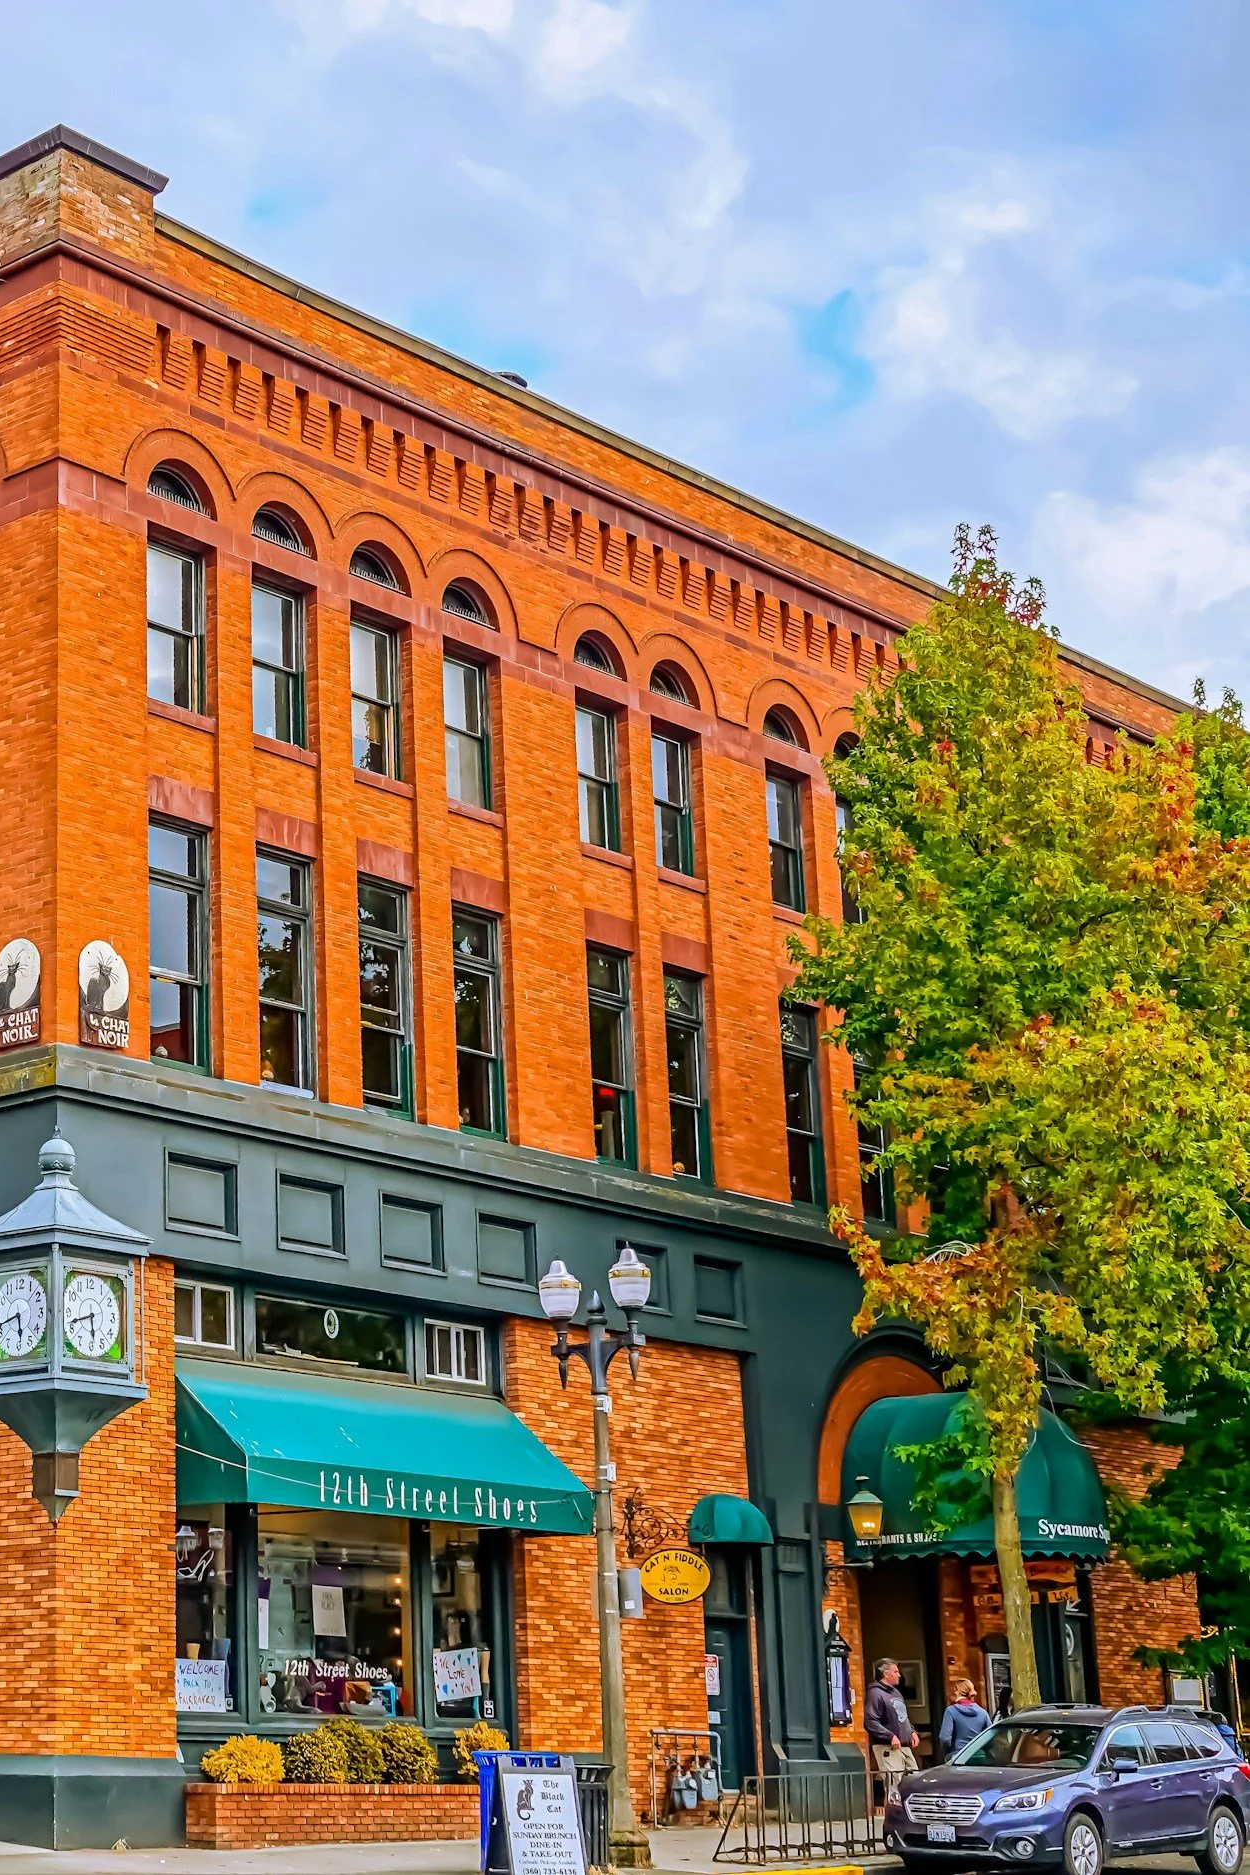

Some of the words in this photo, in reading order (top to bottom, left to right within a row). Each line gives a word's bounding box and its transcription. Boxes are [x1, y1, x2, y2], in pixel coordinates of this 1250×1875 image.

[7, 1008, 39, 1027] CHAT
[101, 1016, 130, 1033] CHAT
[2, 1025, 39, 1044] NOIR
[98, 1030, 130, 1048] NOIR
[6, 1283, 13, 1295] 11
[15, 1278, 25, 1291] 12
[76, 1281, 83, 1293] 11
[86, 1278, 95, 1290] 12
[35, 1291, 41, 1302] 2
[68, 1291, 77, 1302] 10
[107, 1297, 112, 1307] 2
[38, 1307, 44, 1319] 3
[65, 1307, 72, 1317] 9
[110, 1312, 116, 1324] 3
[33, 1322, 40, 1335] 4
[69, 1322, 75, 1335] 8
[107, 1328, 114, 1340] 4
[6, 1338, 11, 1350] 7
[16, 1339, 22, 1351] 6
[26, 1335, 33, 1347] 5
[78, 1335, 84, 1347] 7
[88, 1340, 94, 1351] 6
[99, 1338, 106, 1350] 5
[319, 1470, 369, 1507] 12th
[386, 1477, 459, 1515] Street
[475, 1486, 537, 1524] Shoes
[1038, 1519, 1098, 1539] Sycamore
[906, 1533, 911, 1543] &
[675, 1552, 704, 1572] FIDDLE
[659, 1587, 689, 1596] SALON
[180, 1663, 219, 1675] WELCOME
[284, 1659, 310, 1676] 12th
[316, 1662, 350, 1679] Street
[355, 1662, 388, 1680] Shoes
[543, 1780, 559, 1789] The
[540, 1792, 565, 1801] Black
[546, 1804, 562, 1813] Cat
[544, 1832, 577, 1840] BRUNCH
